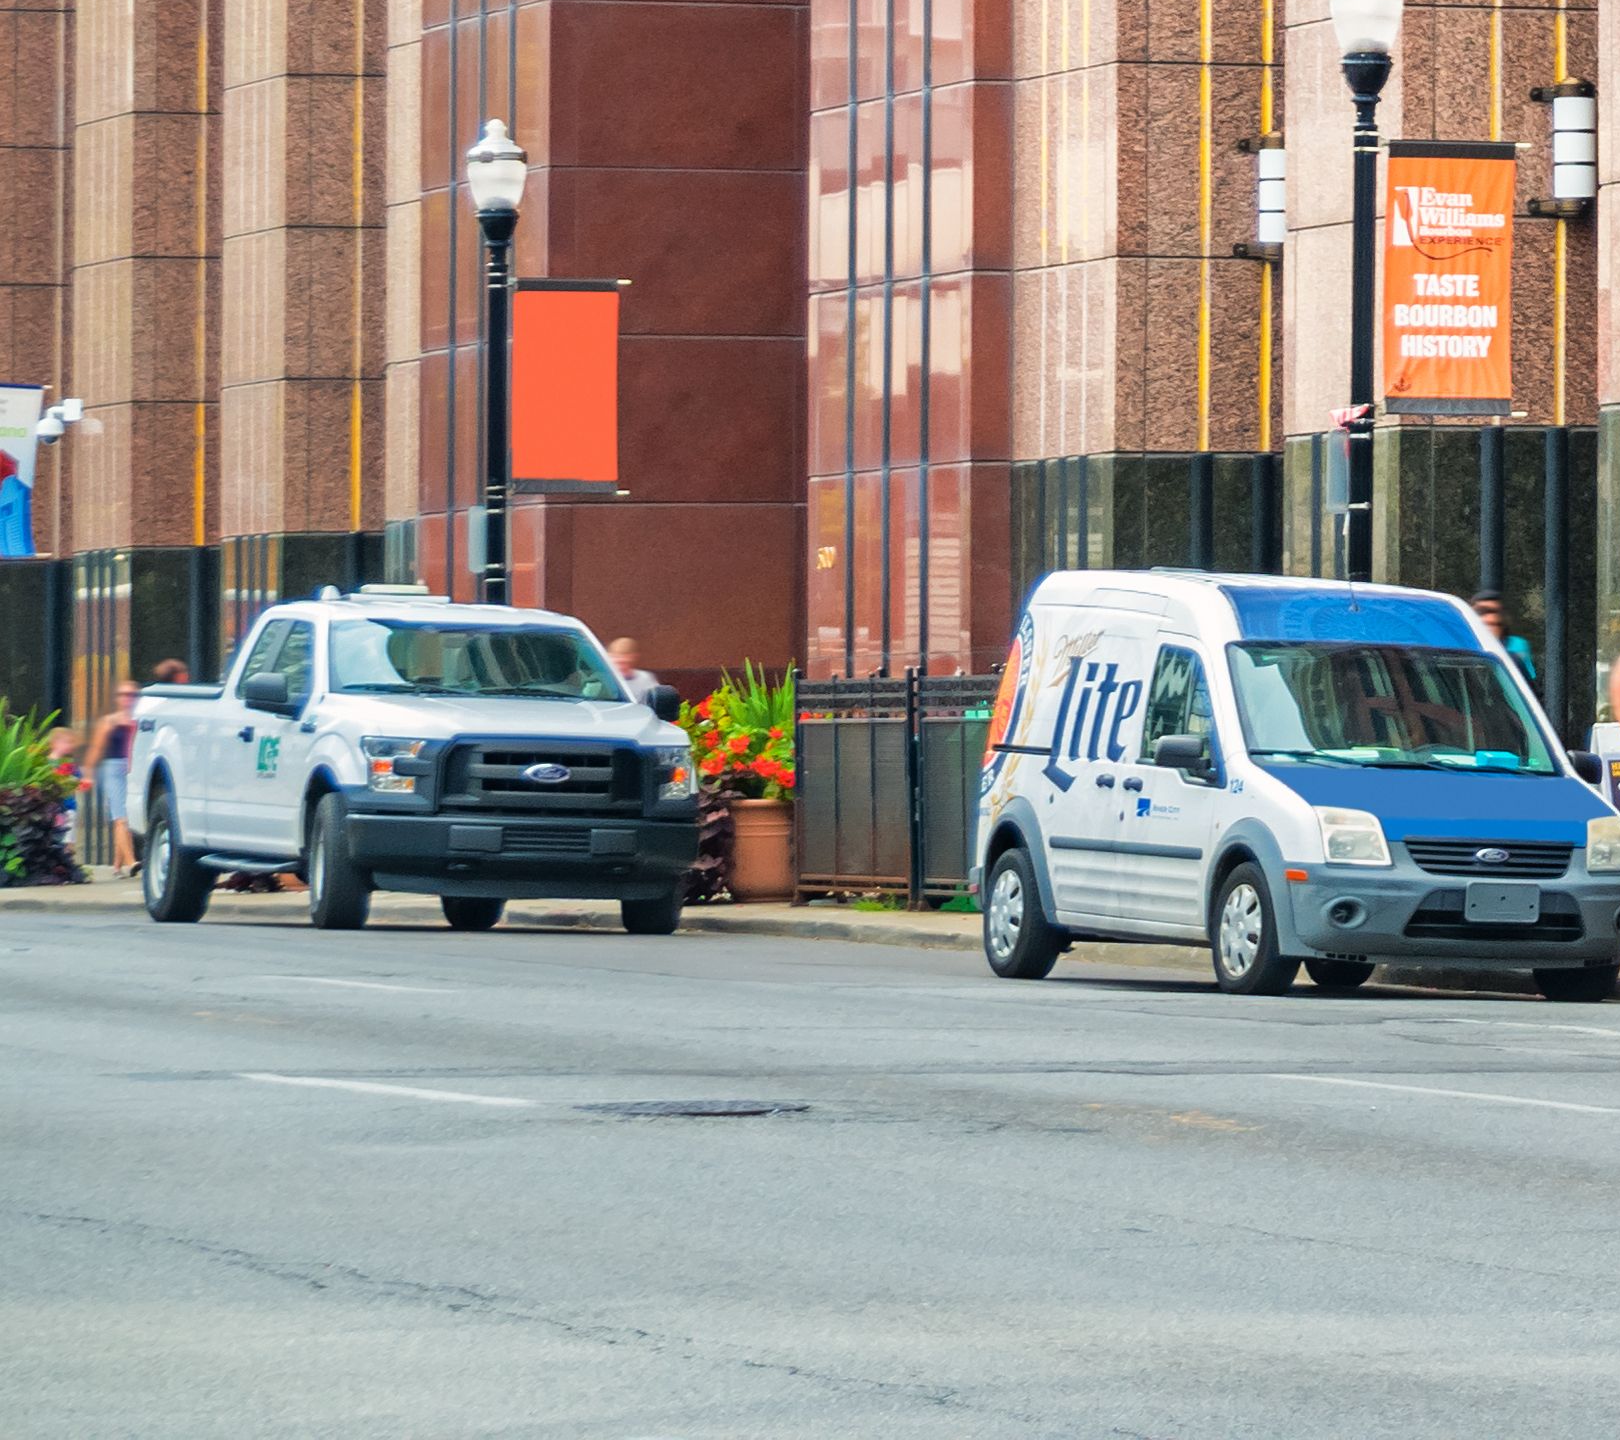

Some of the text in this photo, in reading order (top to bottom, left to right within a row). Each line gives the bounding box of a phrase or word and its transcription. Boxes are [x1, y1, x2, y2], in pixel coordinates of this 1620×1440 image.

[1420, 186, 1473, 207] Evan
[1419, 207, 1505, 227] Williams
[1420, 237, 1504, 245] EXPERIENCE
[1413, 273, 1480, 297] TASTE
[1394, 304, 1498, 328] BOURBON
[1401, 334, 1492, 358] HISTORY
[1042, 656, 1143, 793] Lite
